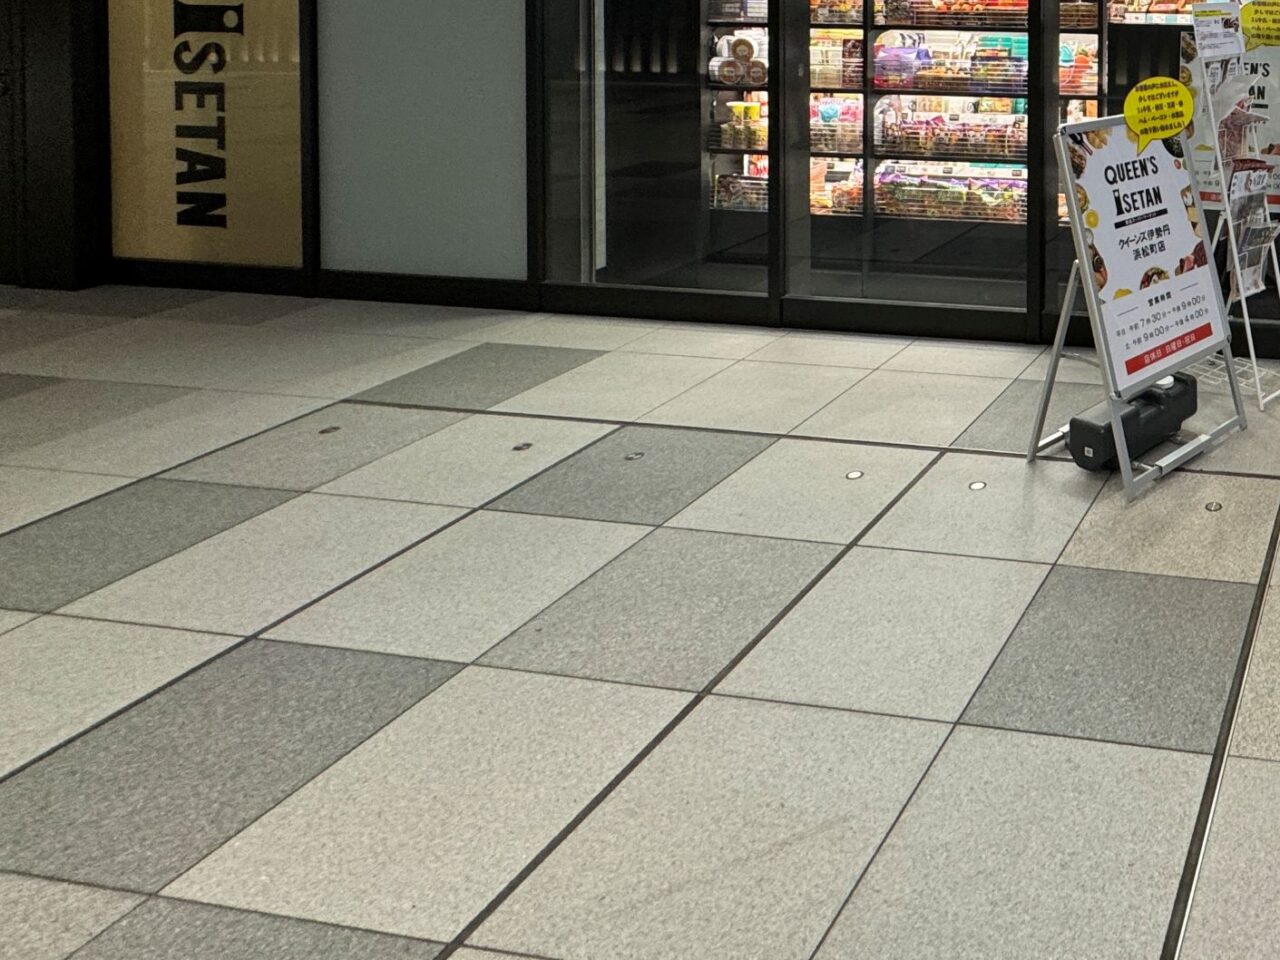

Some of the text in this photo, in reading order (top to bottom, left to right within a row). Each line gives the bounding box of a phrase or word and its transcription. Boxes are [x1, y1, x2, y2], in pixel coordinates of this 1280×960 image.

[1104, 156, 1159, 185] QUEEN'S
[1112, 186, 1163, 216] ISETAN
[1118, 224, 1171, 250] クイーンズ伊勢丹
[1132, 240, 1166, 261] 浜松町店
